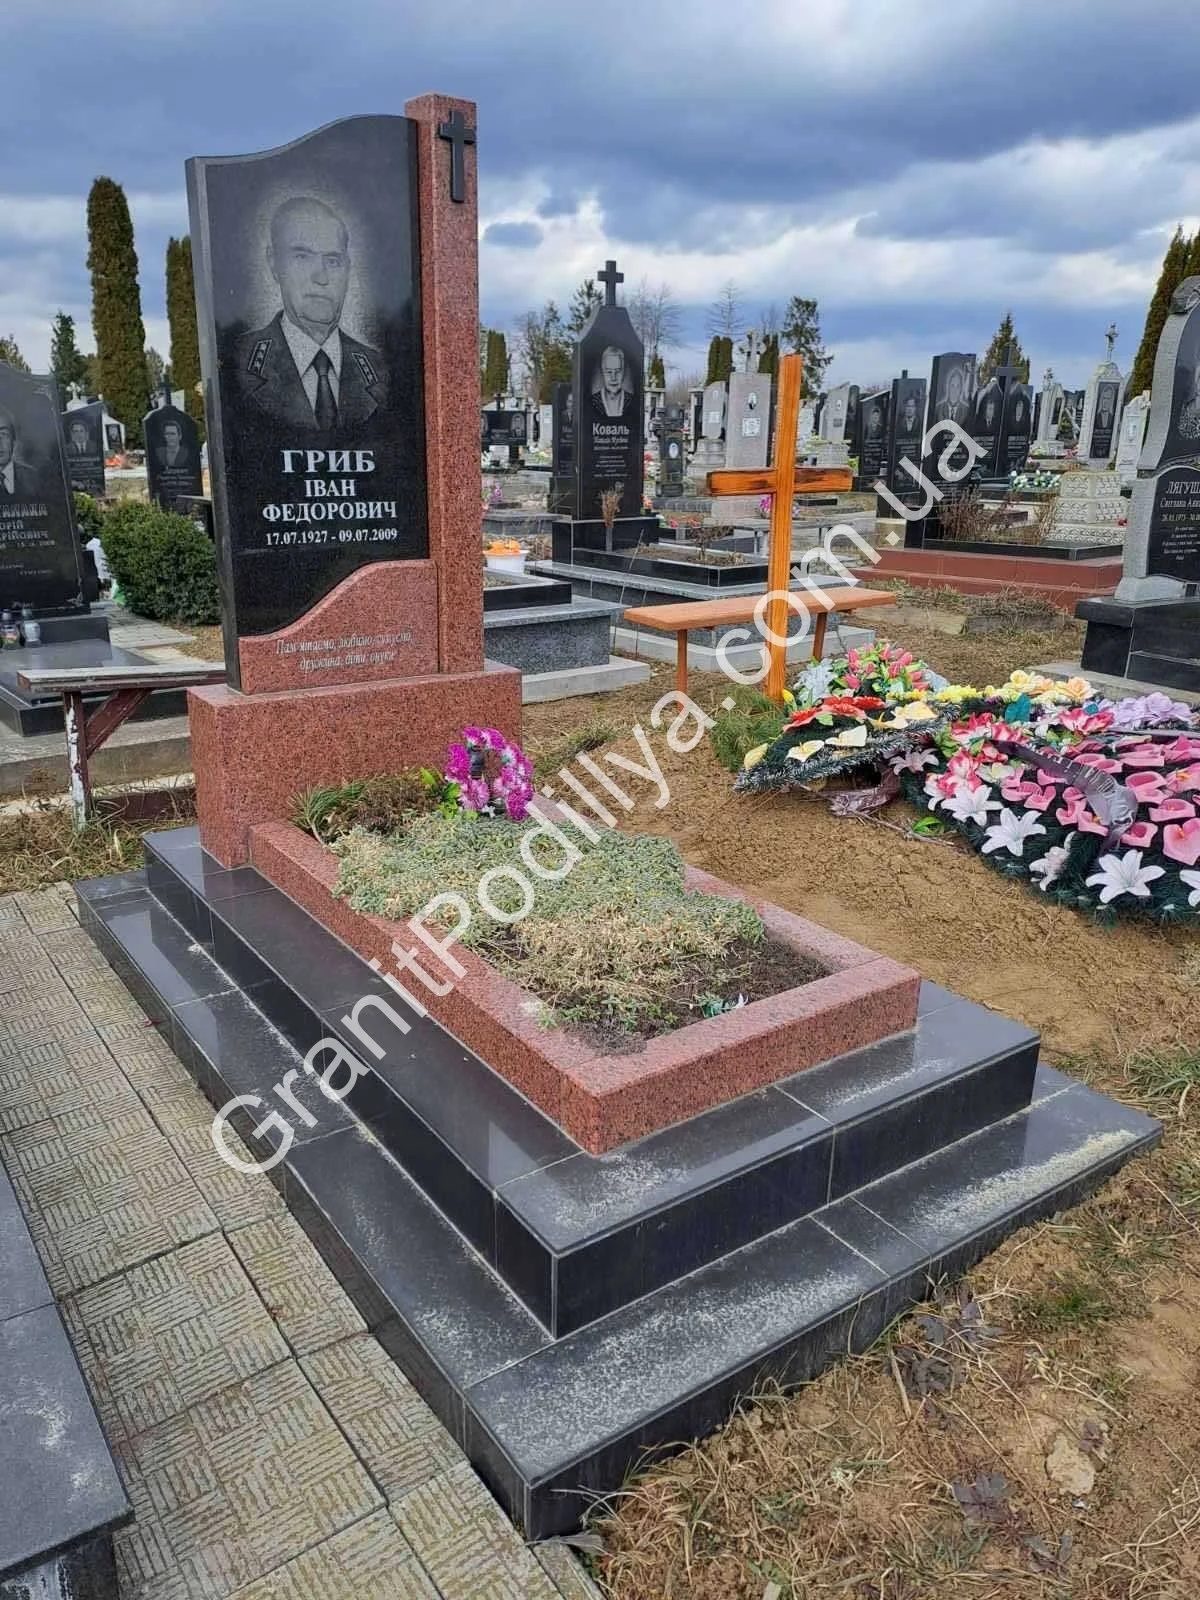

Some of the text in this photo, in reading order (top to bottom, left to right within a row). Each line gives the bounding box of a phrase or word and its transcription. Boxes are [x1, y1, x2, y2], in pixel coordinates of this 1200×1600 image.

[592, 423, 630, 436] Коваль
[281, 450, 376, 473] ГРИБ
[305, 479, 356, 497] ІВАН
[1166, 481, 1200, 495] ЛЯГУШ
[262, 501, 398, 525] ФЕДОРОВИЧ
[266, 530, 328, 546] 17.07.1927
[339, 528, 398, 543] 09.07.2009
